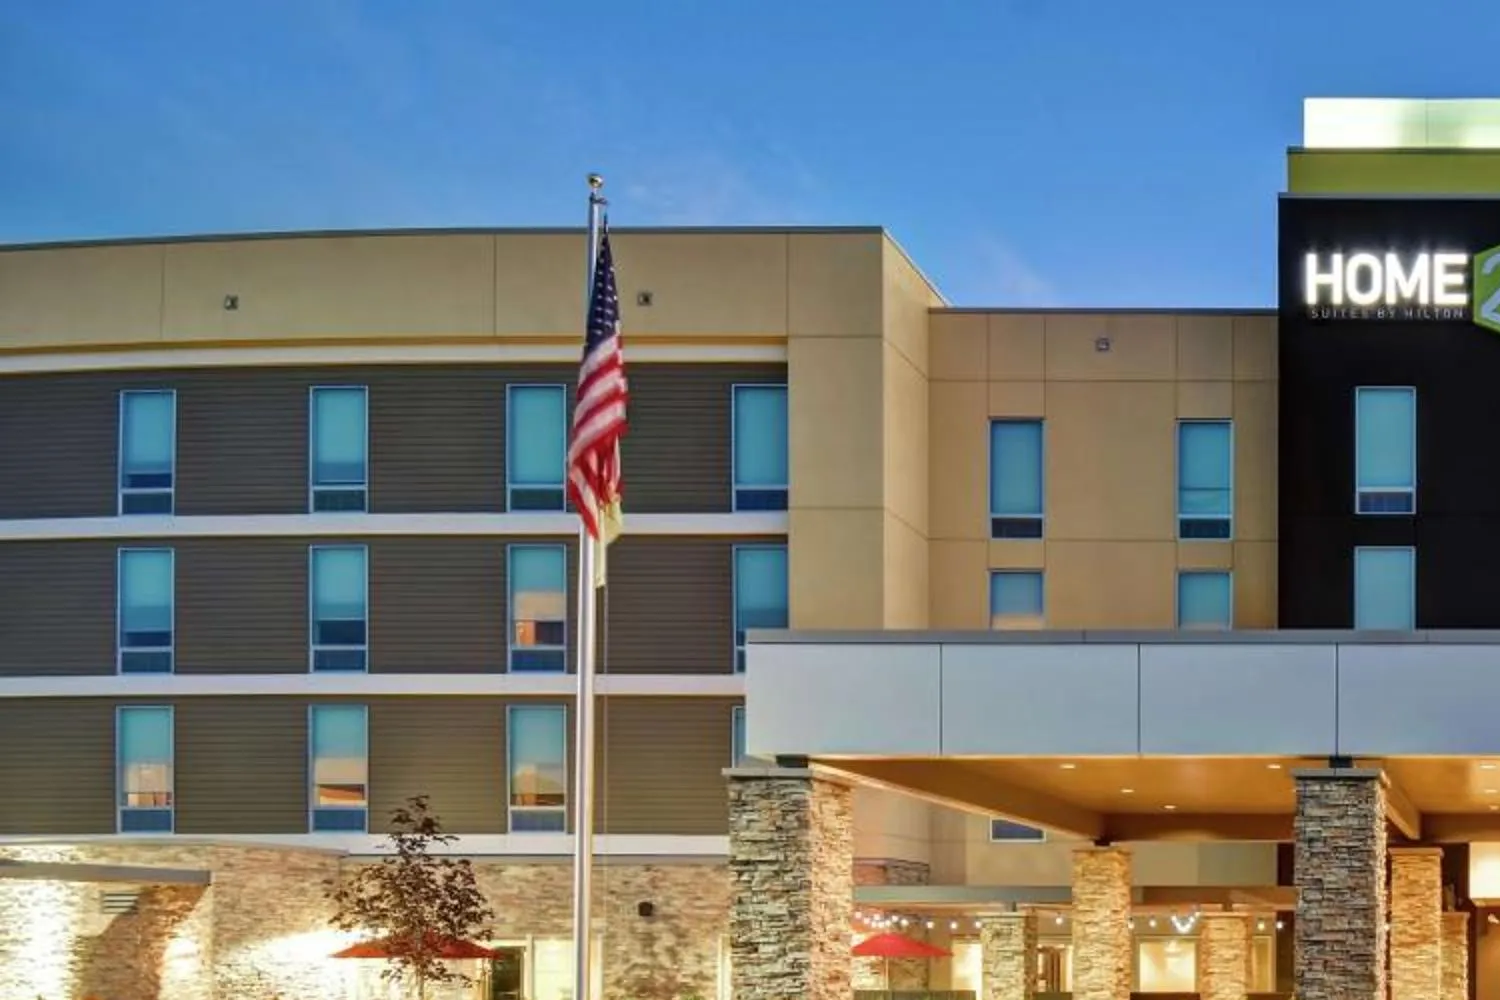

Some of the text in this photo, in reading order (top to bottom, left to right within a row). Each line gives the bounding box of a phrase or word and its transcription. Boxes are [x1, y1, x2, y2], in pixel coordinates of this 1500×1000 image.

[1305, 253, 1468, 305] HOME
[1311, 307, 1464, 319] SUITES BY HILTON
